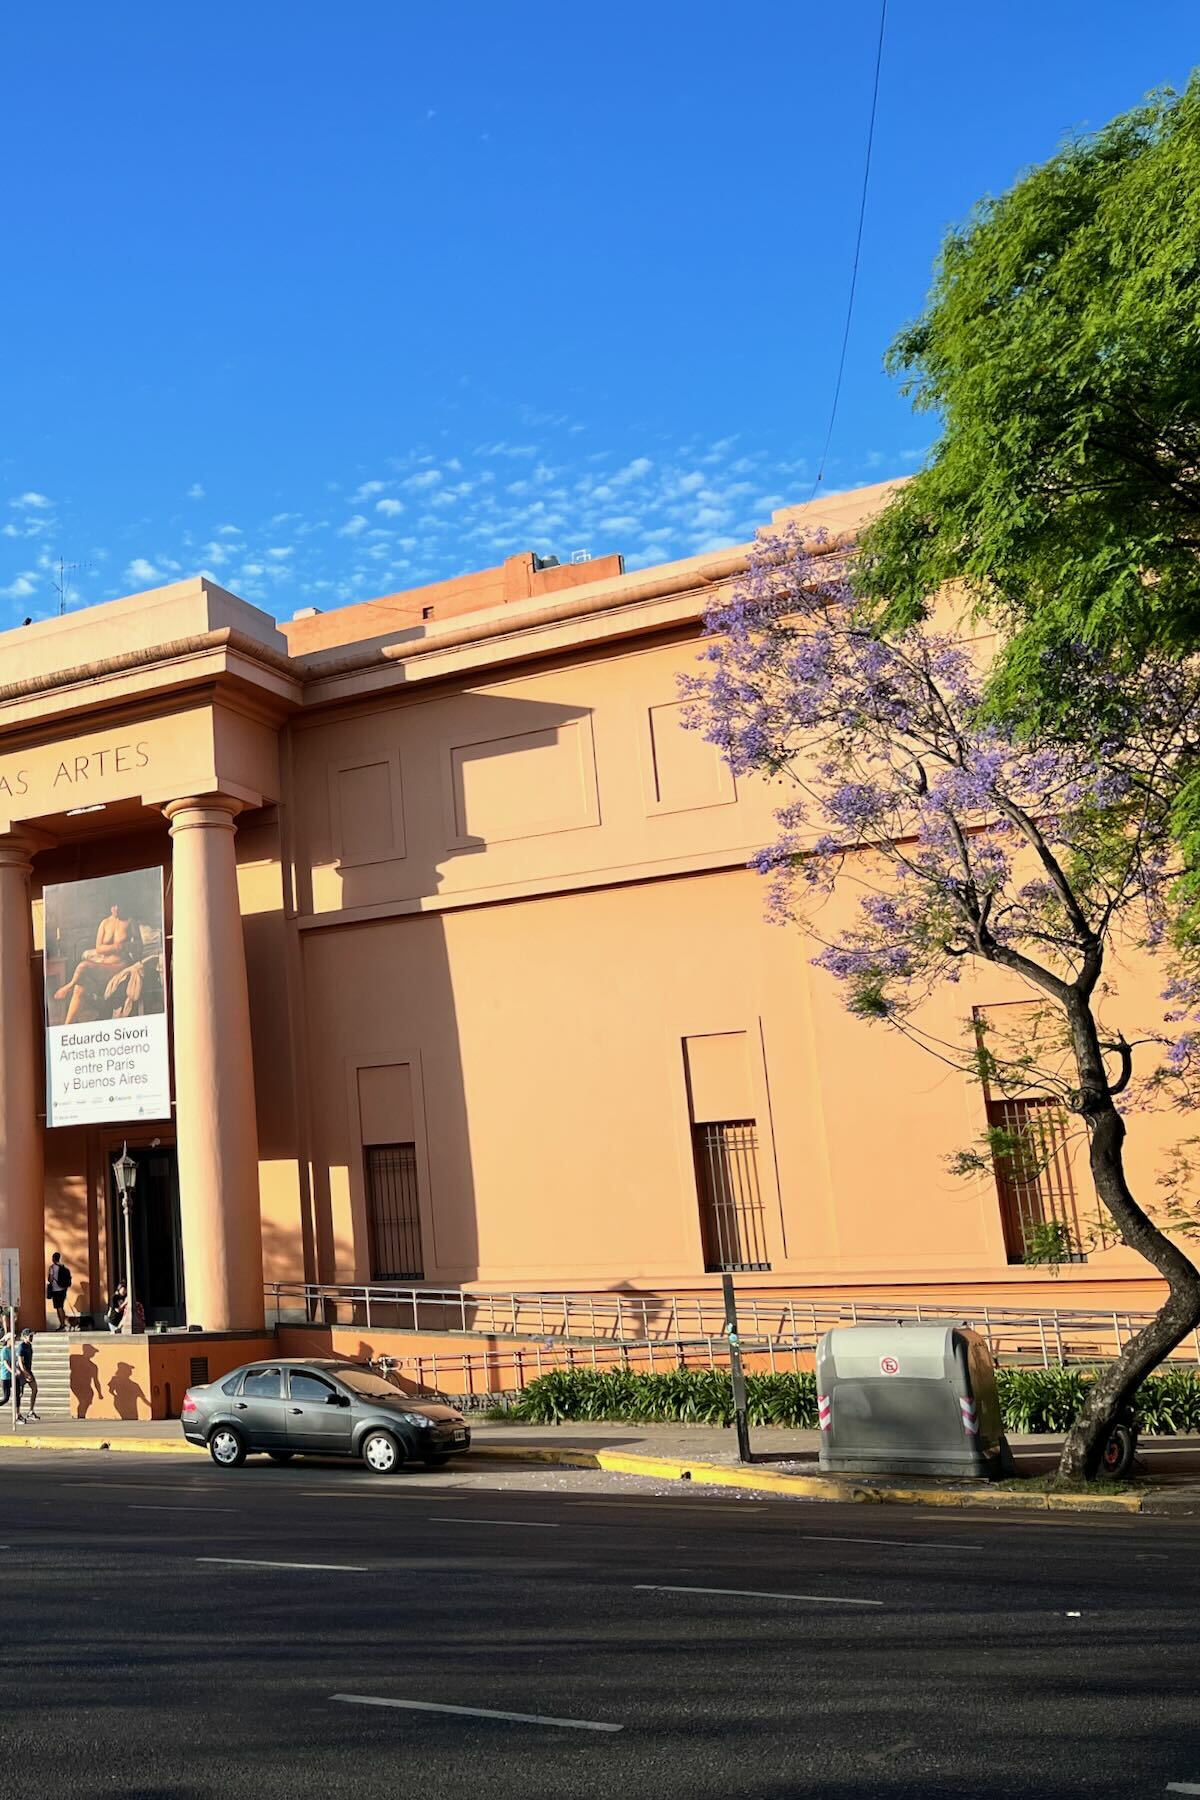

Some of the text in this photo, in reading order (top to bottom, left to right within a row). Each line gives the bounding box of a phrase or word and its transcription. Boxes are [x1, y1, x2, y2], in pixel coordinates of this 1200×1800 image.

[53, 741, 149, 787] ARTES
[61, 1031, 111, 1047] Eduardo
[59, 1042, 151, 1062] Artista moderno
[74, 1063, 103, 1075] entre
[63, 1072, 149, 1094] y Buenos Aires
